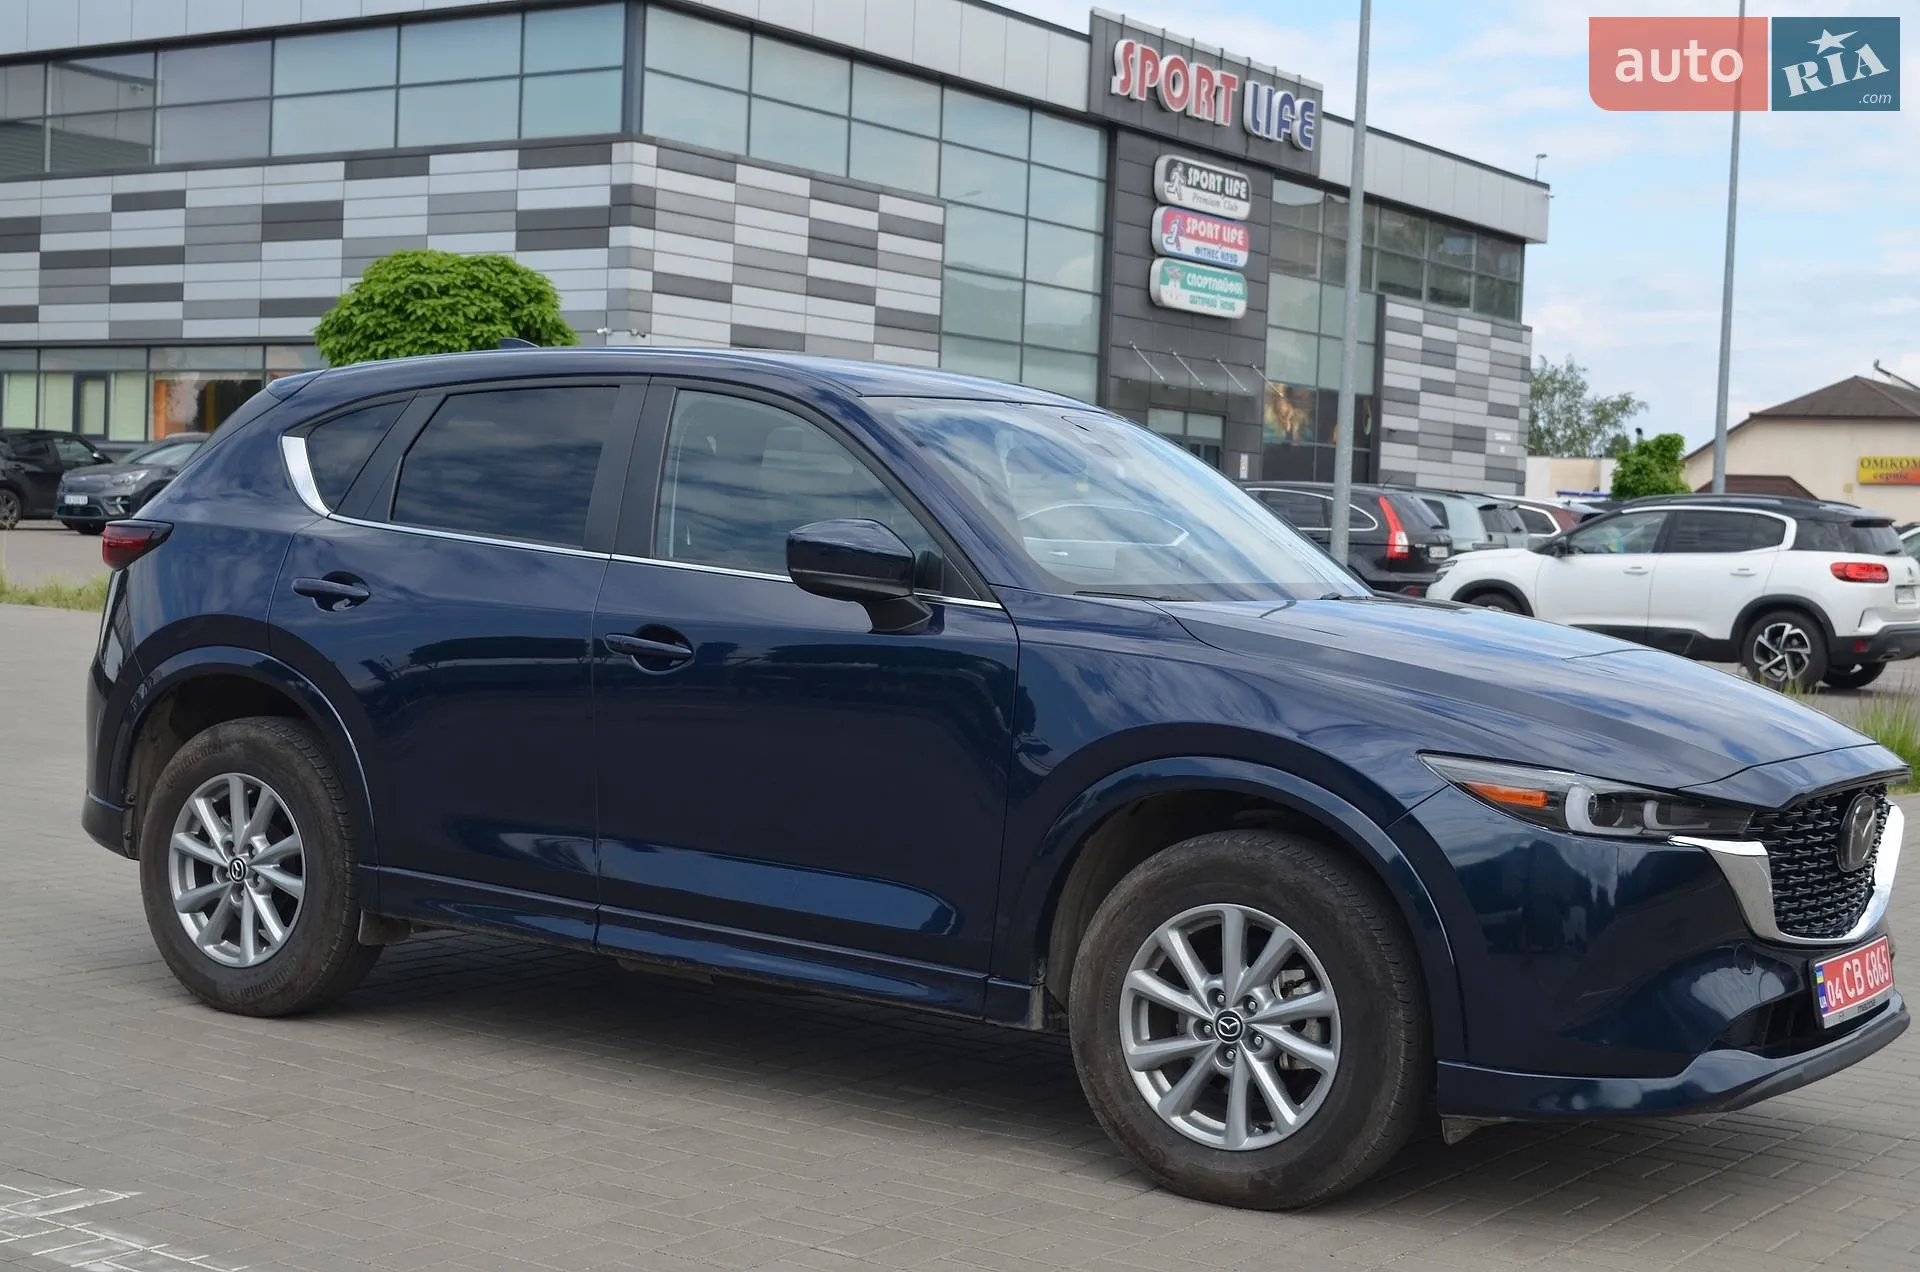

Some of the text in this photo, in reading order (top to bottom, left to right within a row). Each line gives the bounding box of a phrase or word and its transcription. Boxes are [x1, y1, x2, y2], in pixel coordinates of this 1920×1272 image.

[1111, 39, 1316, 151] SPORT LIFE
[1187, 167, 1247, 199] SPORT LIFE
[1192, 193, 1239, 212] Premium Club
[1186, 217, 1245, 246] SPORT LIFE
[1827, 945, 1889, 1007] 04 CB 6865
